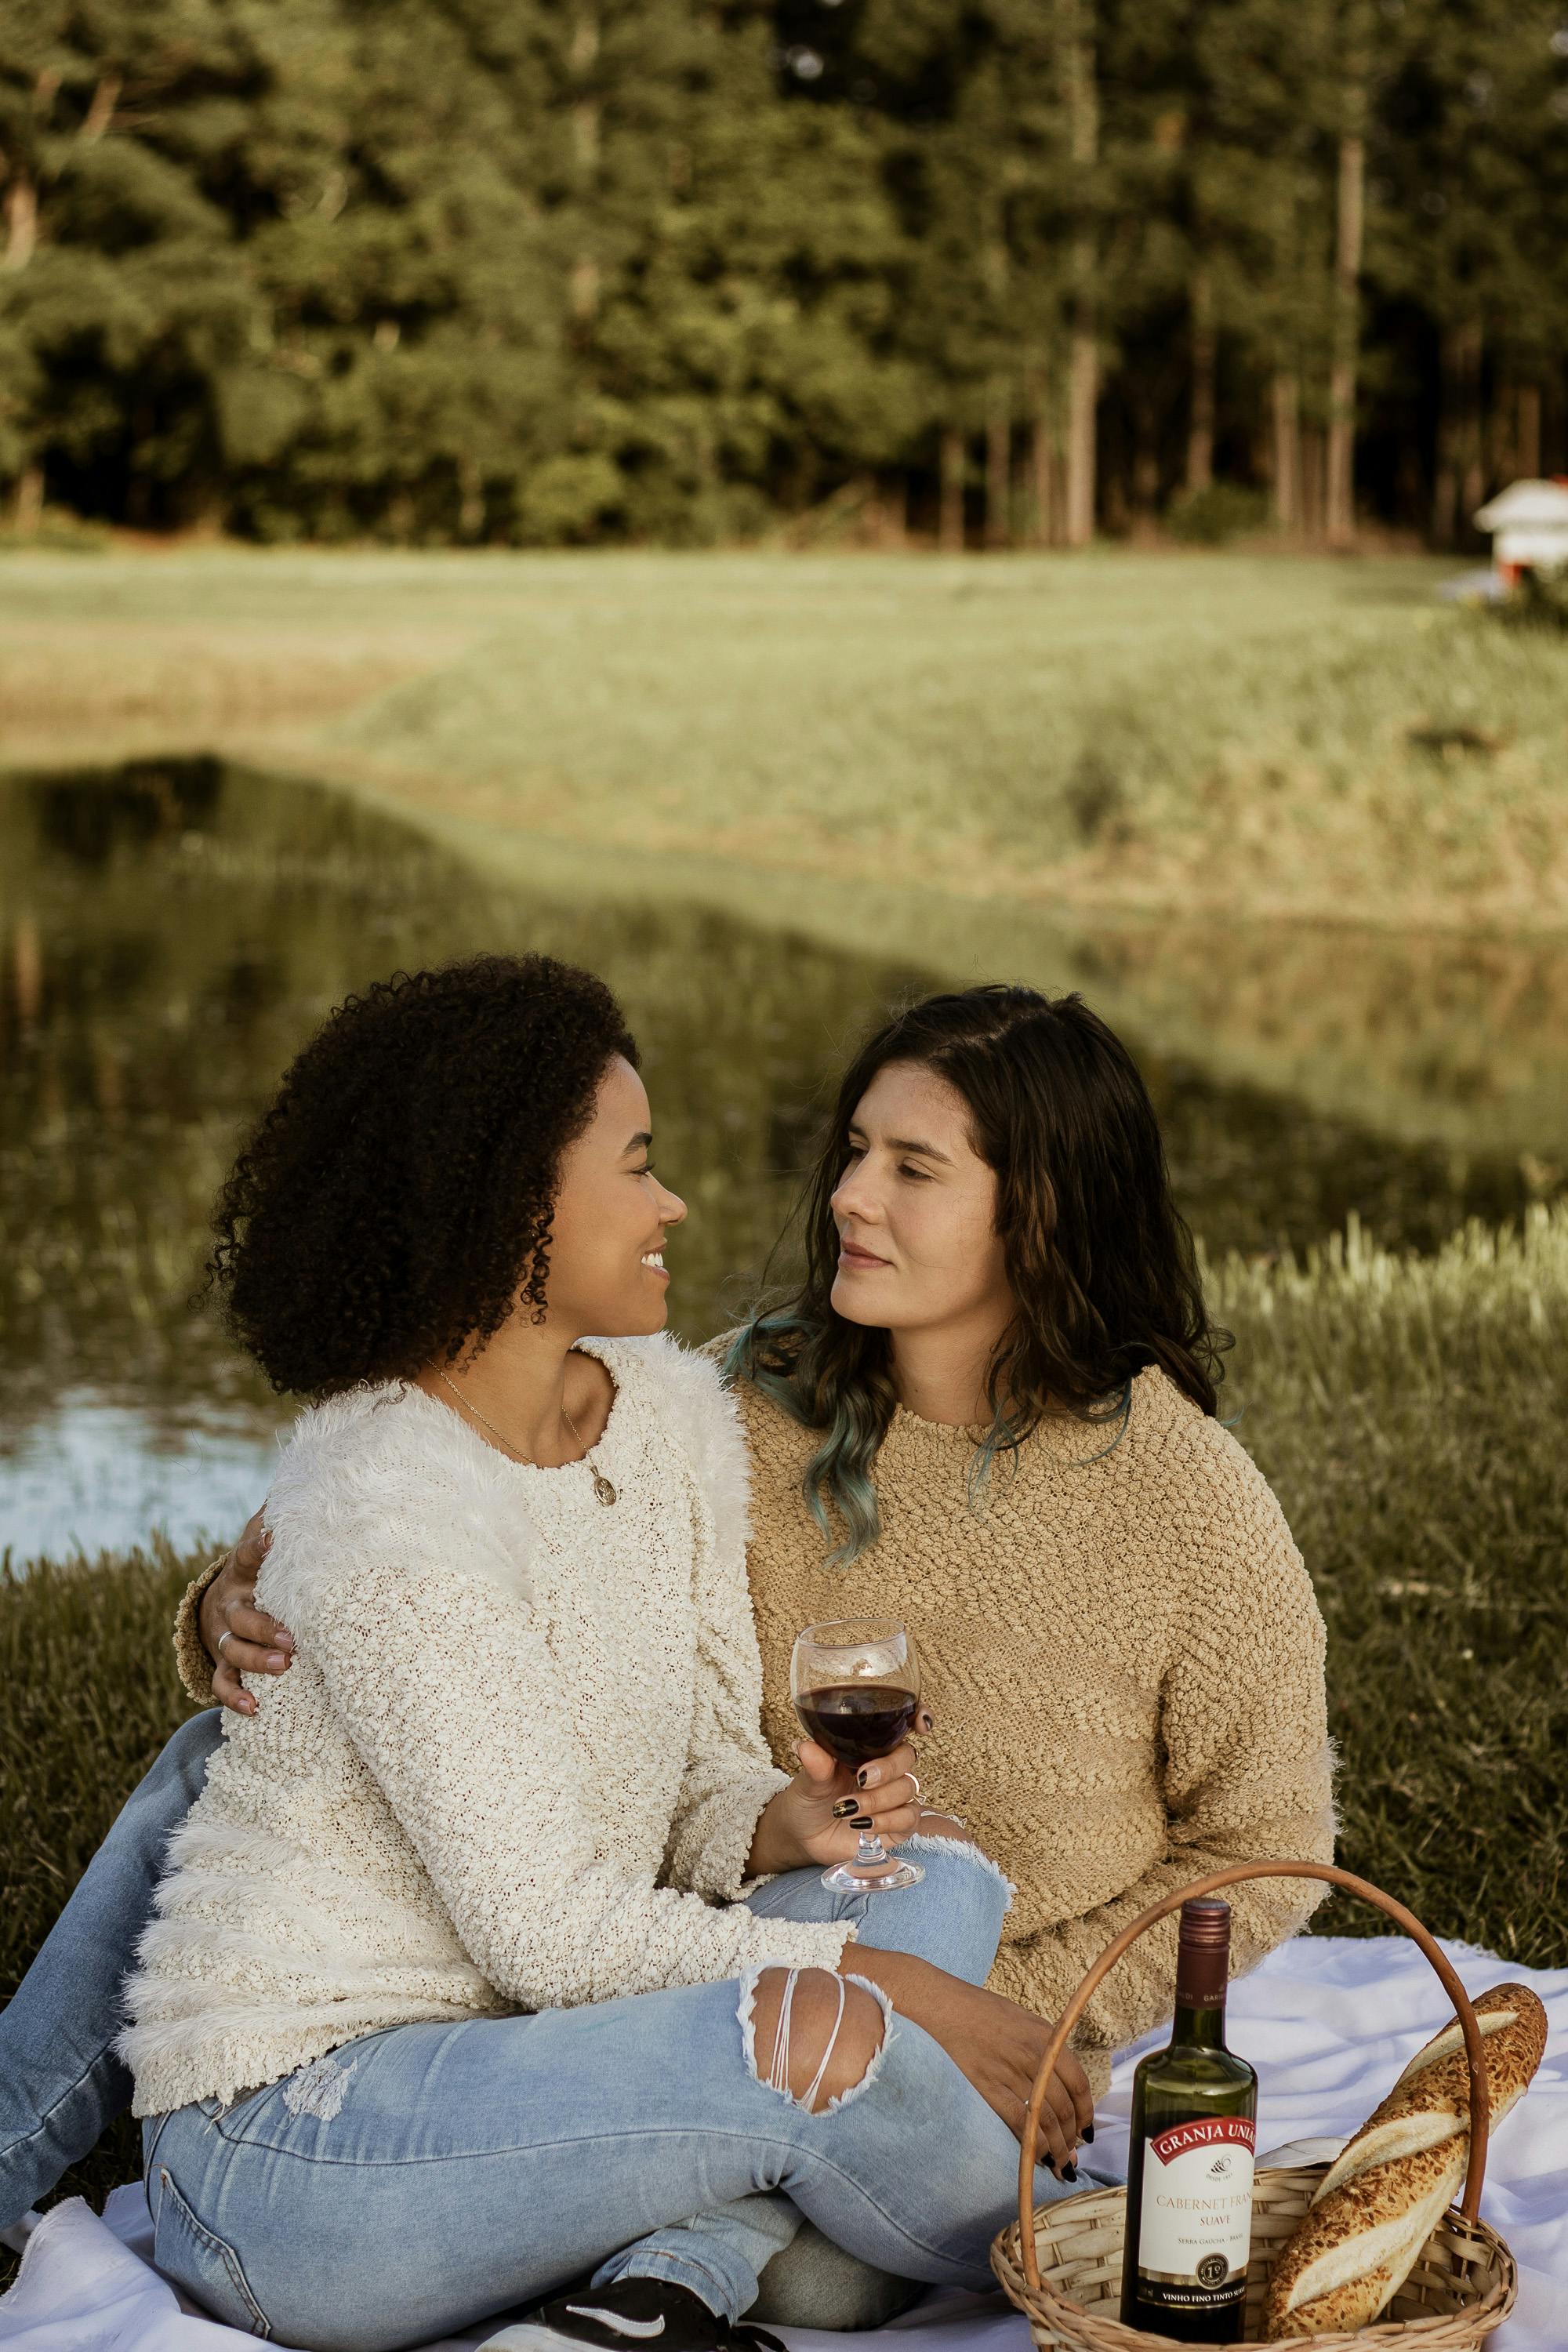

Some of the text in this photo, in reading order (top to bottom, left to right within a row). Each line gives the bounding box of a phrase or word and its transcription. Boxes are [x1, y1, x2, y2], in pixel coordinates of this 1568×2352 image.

[1160, 2125, 1224, 2154] GRANJA
[1156, 2194, 1228, 2211] CABERNET
[1200, 2215, 1231, 2227] SUAVE
[1163, 2292, 1190, 2302] VINHO
[1192, 2294, 1211, 2303] FINO
[1213, 2291, 1233, 2301] TINTO
